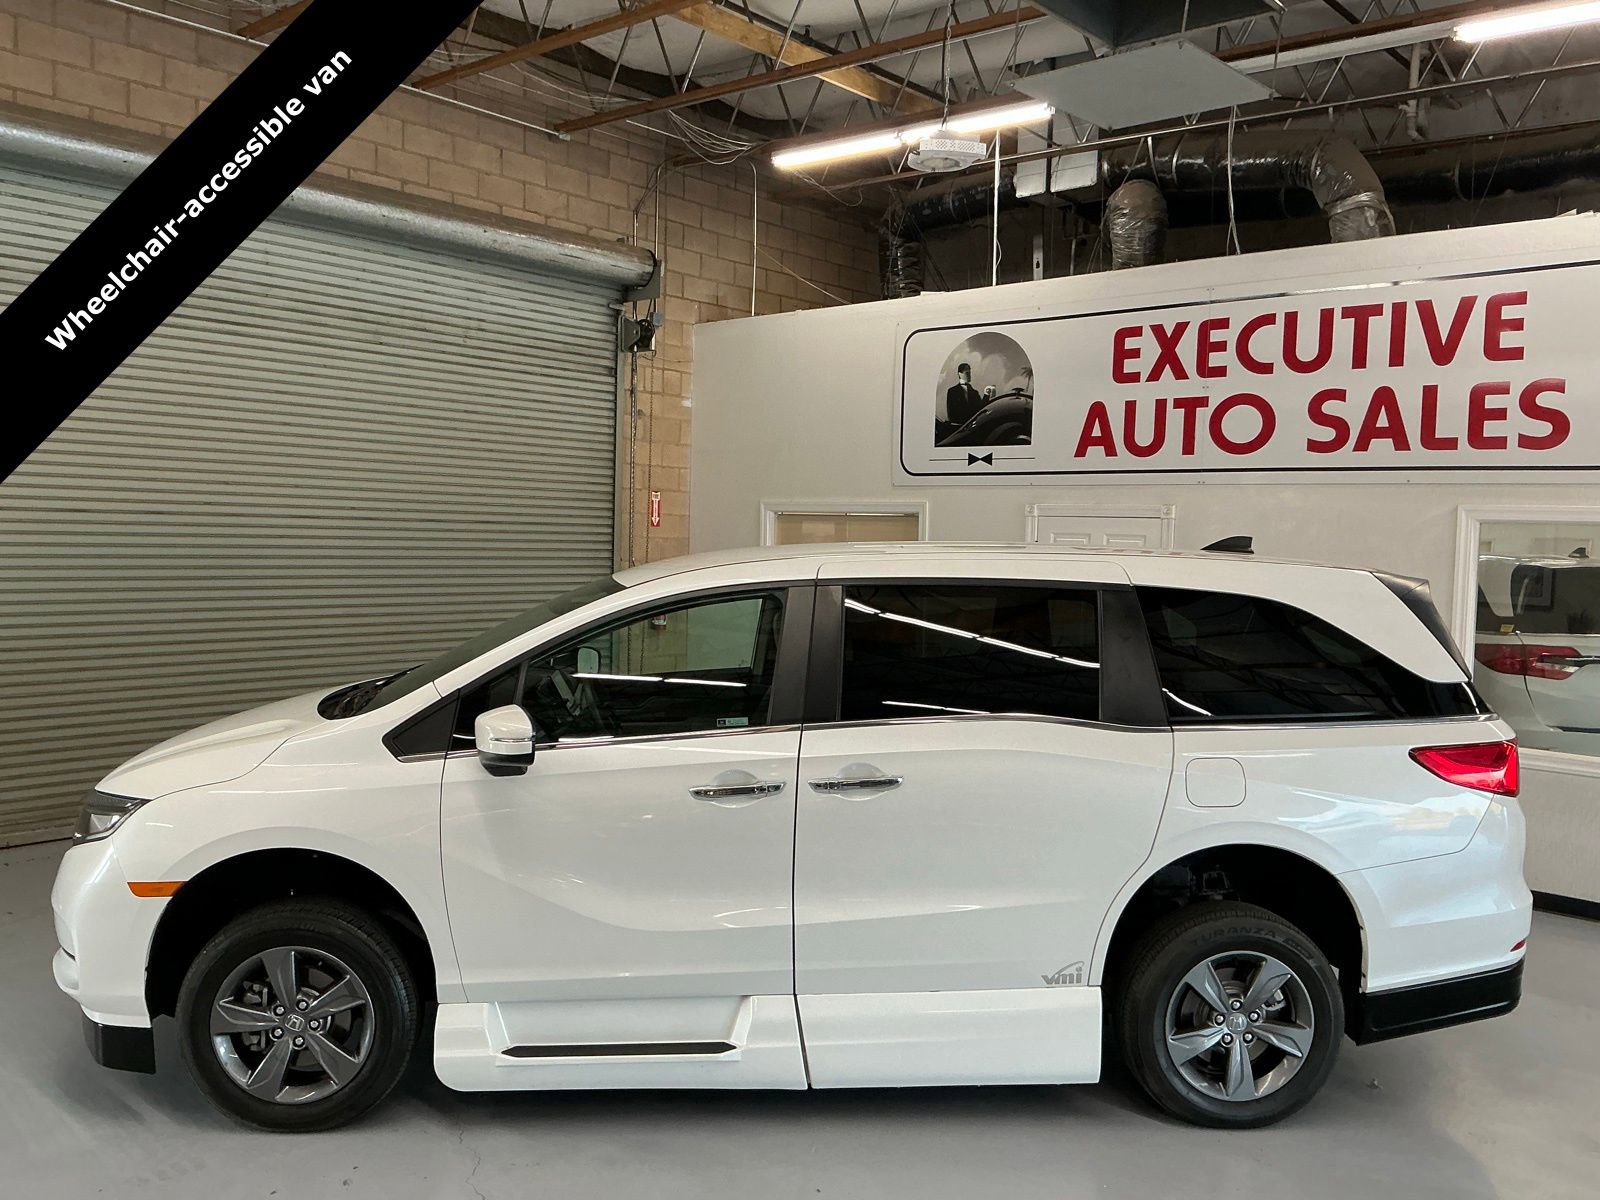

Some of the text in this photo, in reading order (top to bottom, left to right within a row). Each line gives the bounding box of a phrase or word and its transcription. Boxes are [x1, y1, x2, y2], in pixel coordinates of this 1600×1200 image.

[1112, 292, 1528, 385] EXECUTIVE
[1074, 379, 1570, 457] AUTO SALES
